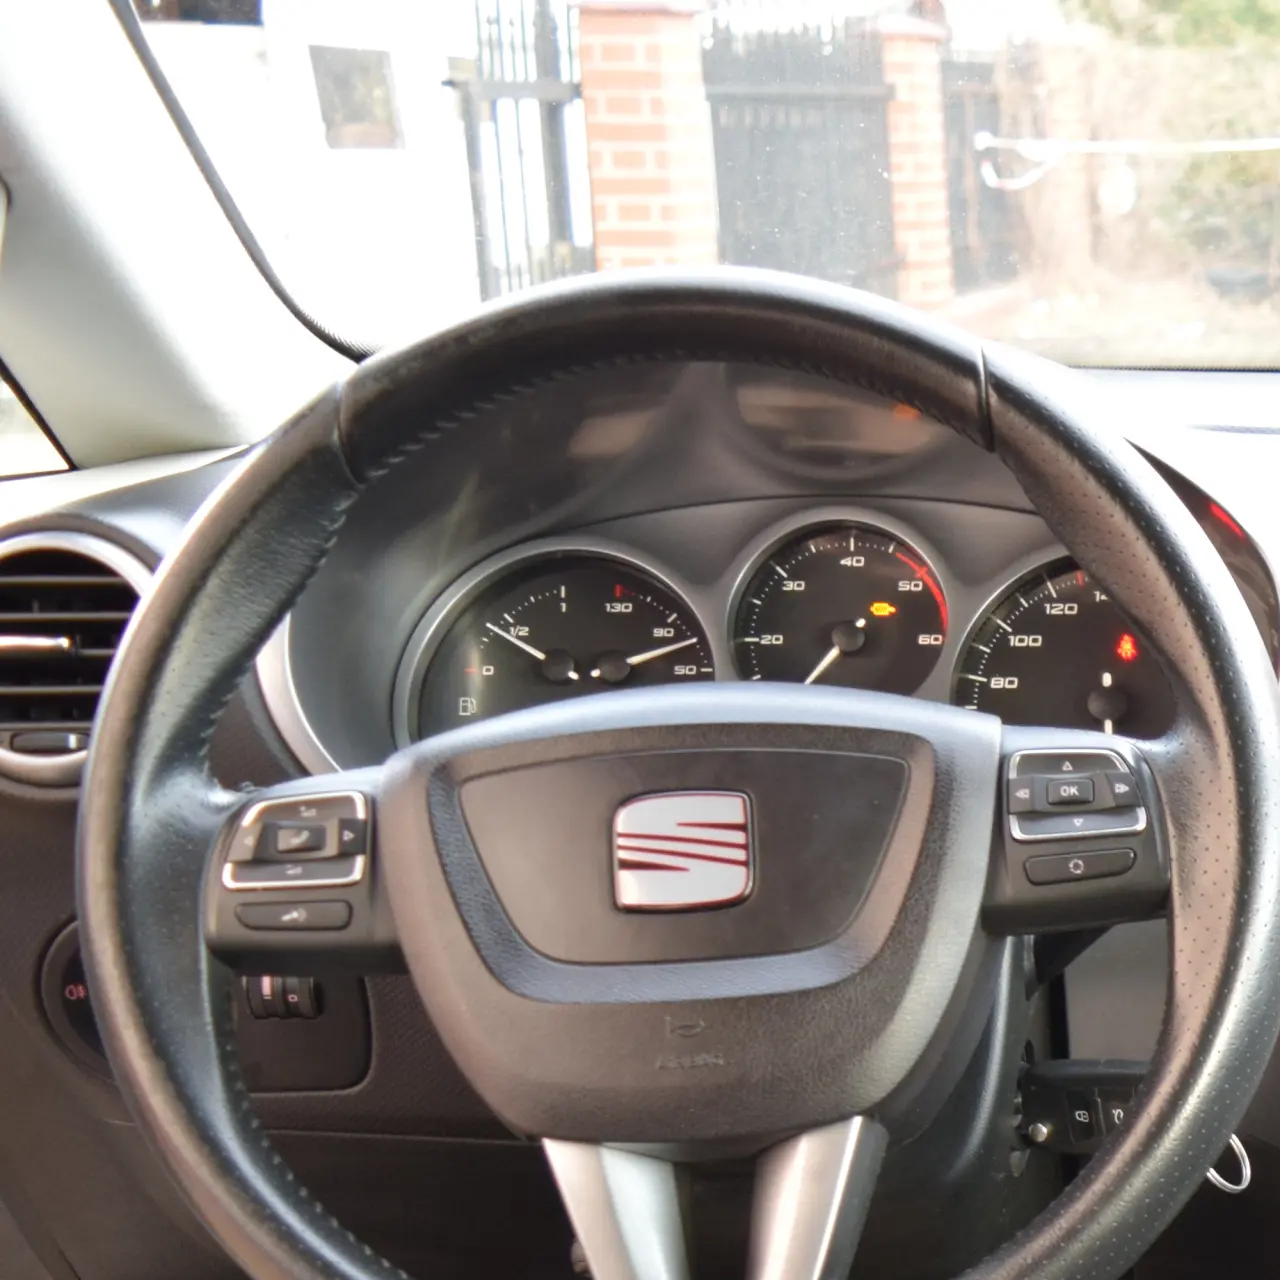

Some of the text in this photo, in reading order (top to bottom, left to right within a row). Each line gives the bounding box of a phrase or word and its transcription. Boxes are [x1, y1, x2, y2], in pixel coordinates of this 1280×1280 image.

[839, 556, 865, 567] 40
[782, 581, 805, 590] 30
[898, 581, 923, 591] 50
[560, 602, 566, 613] 1
[604, 603, 633, 613] 130
[1044, 603, 1078, 615] 120
[509, 626, 530, 636] 1/2
[653, 627, 675, 637] 90
[760, 635, 784, 645] 20
[918, 635, 943, 645] 60
[1008, 635, 1042, 647] 100
[482, 665, 494, 676] 0
[674, 665, 697, 676] 50
[990, 677, 1018, 689] 80
[1060, 785, 1079, 797] OK
